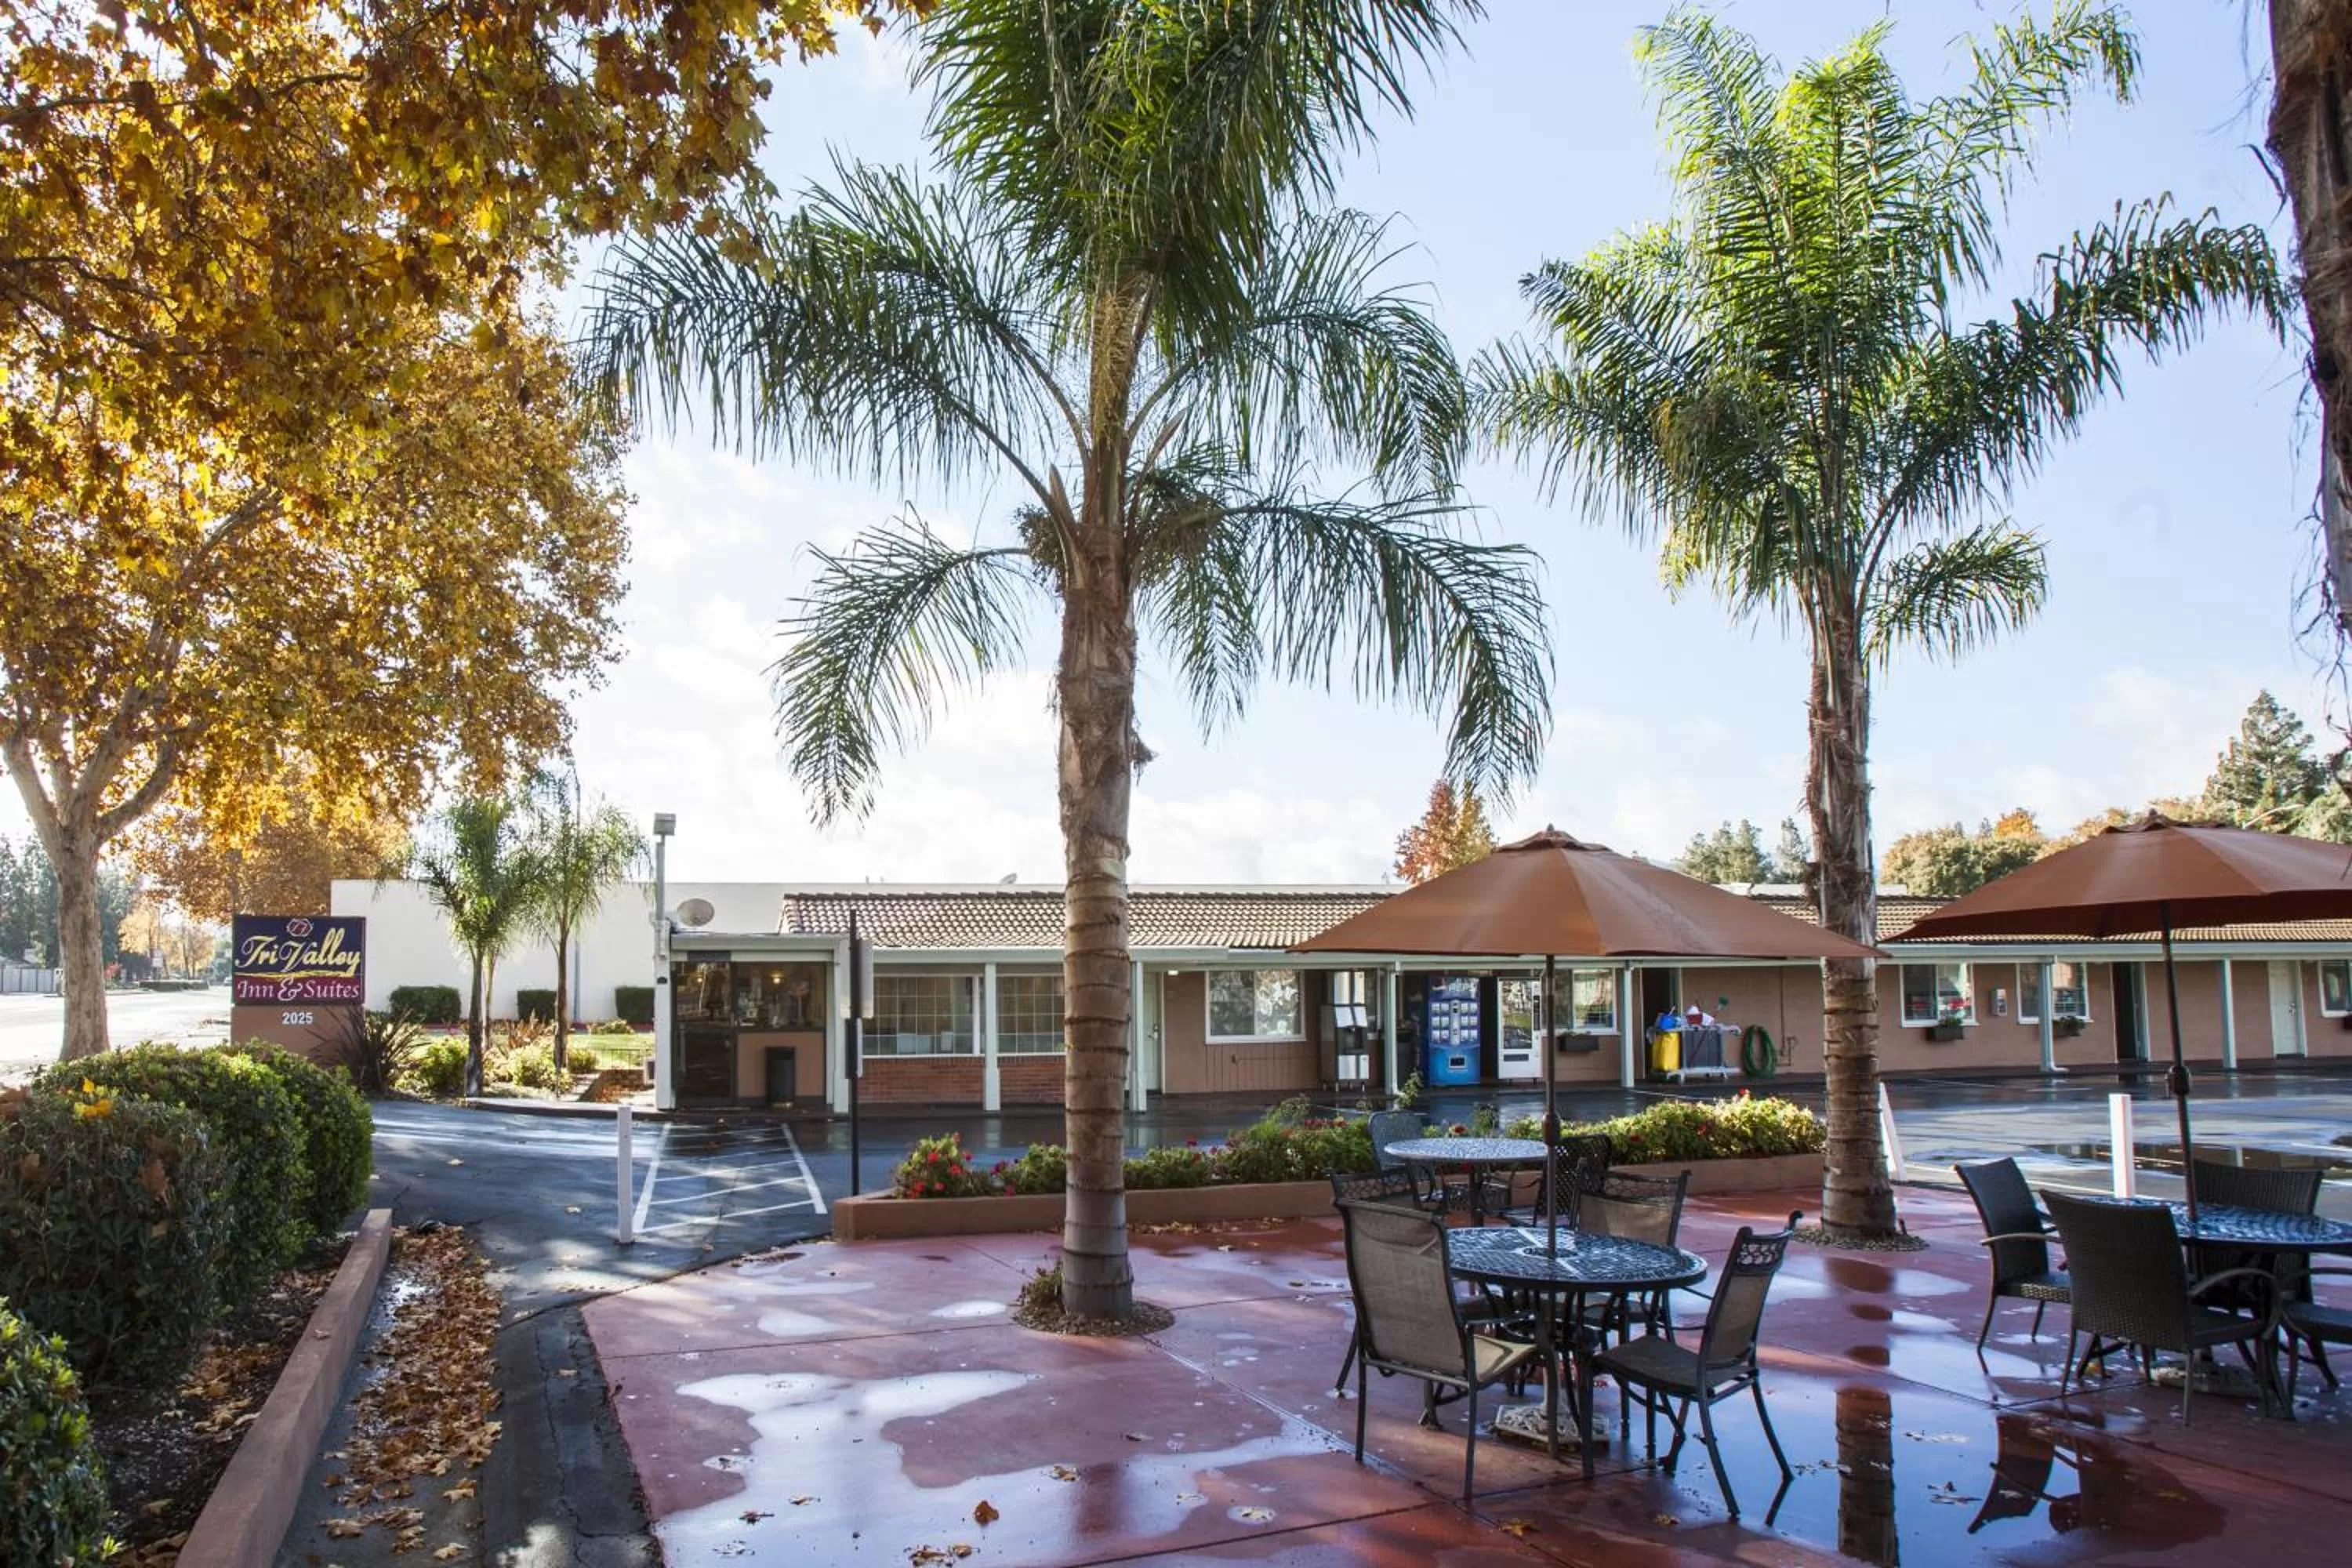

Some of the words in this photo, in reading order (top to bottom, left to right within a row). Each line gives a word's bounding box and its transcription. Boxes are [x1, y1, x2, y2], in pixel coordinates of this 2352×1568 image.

[235, 935, 278, 968] Tri
[279, 927, 361, 976] Valley
[238, 980, 274, 998] Inn
[277, 977, 303, 1001] &
[303, 980, 360, 998] Suites
[281, 1012, 314, 1025] 2025
